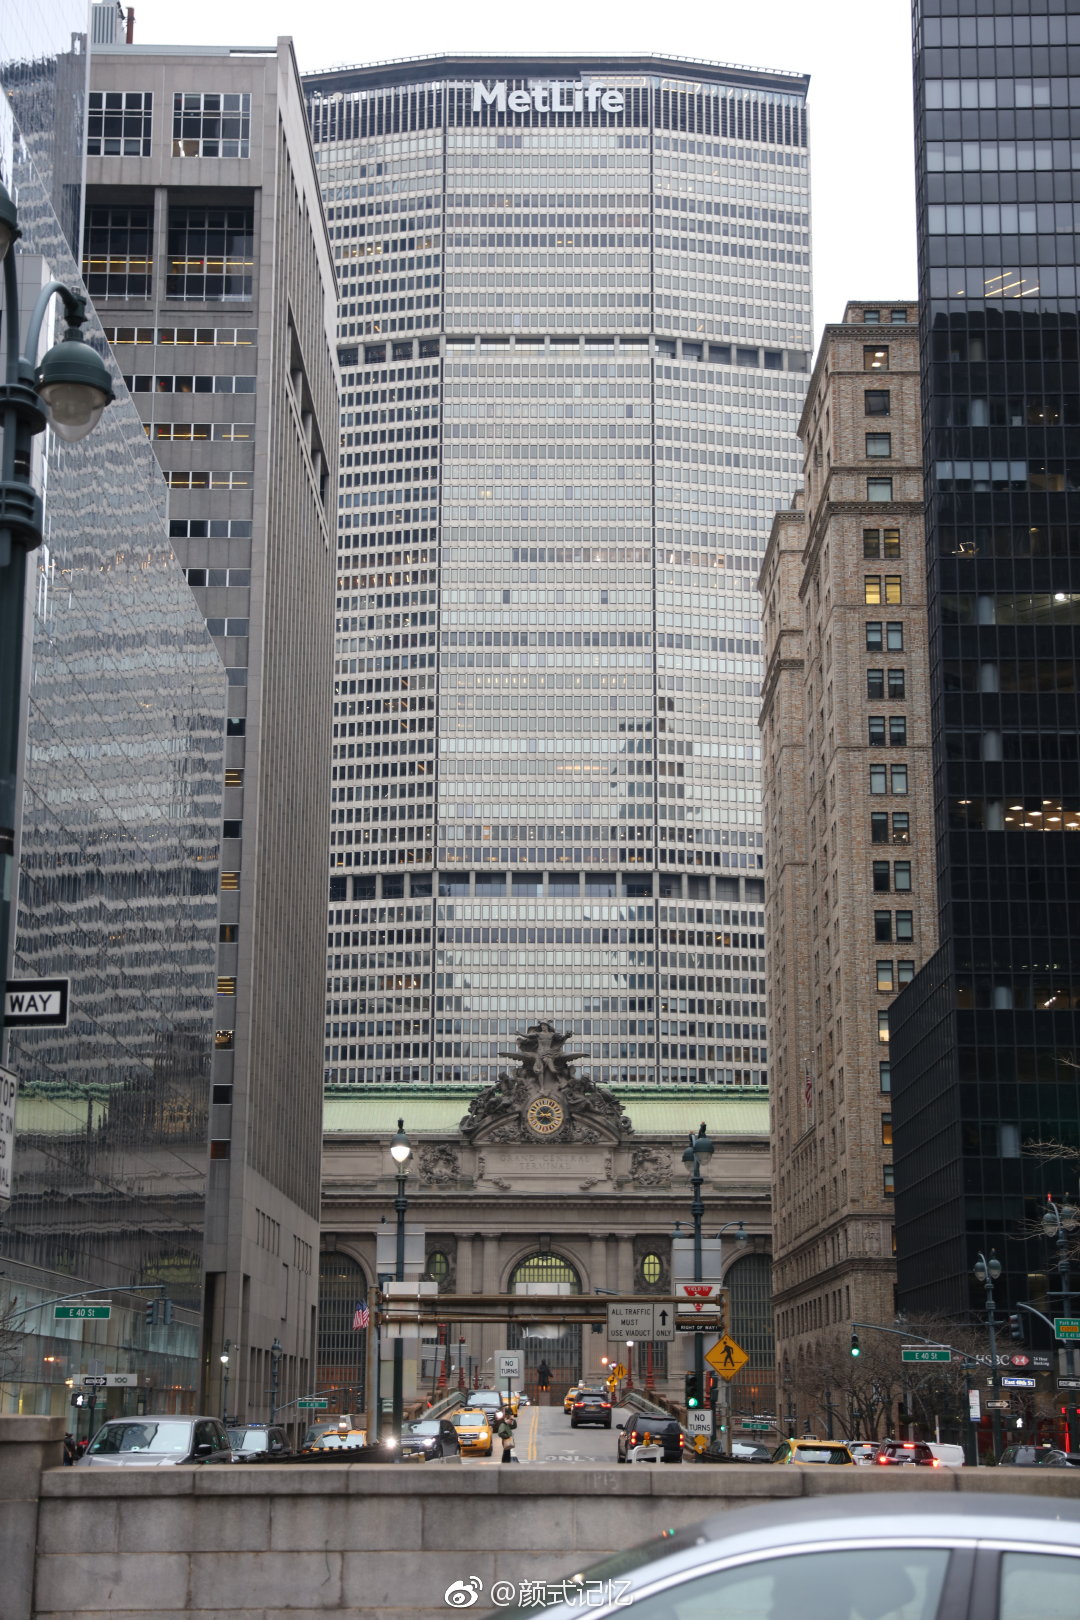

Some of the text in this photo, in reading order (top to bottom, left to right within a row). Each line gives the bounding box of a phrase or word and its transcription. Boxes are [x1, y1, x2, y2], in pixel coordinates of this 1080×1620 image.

[472, 81, 625, 113] MetLife
[9, 993, 53, 1013] WAY
[69, 1308, 96, 1317] E 40 St
[611, 1308, 651, 1316] ALL TRAFFIC
[621, 1319, 639, 1327] MUST
[915, 1352, 938, 1360] E 40 St
[694, 1413, 706, 1422] NO
[689, 1423, 711, 1432] TURNS
